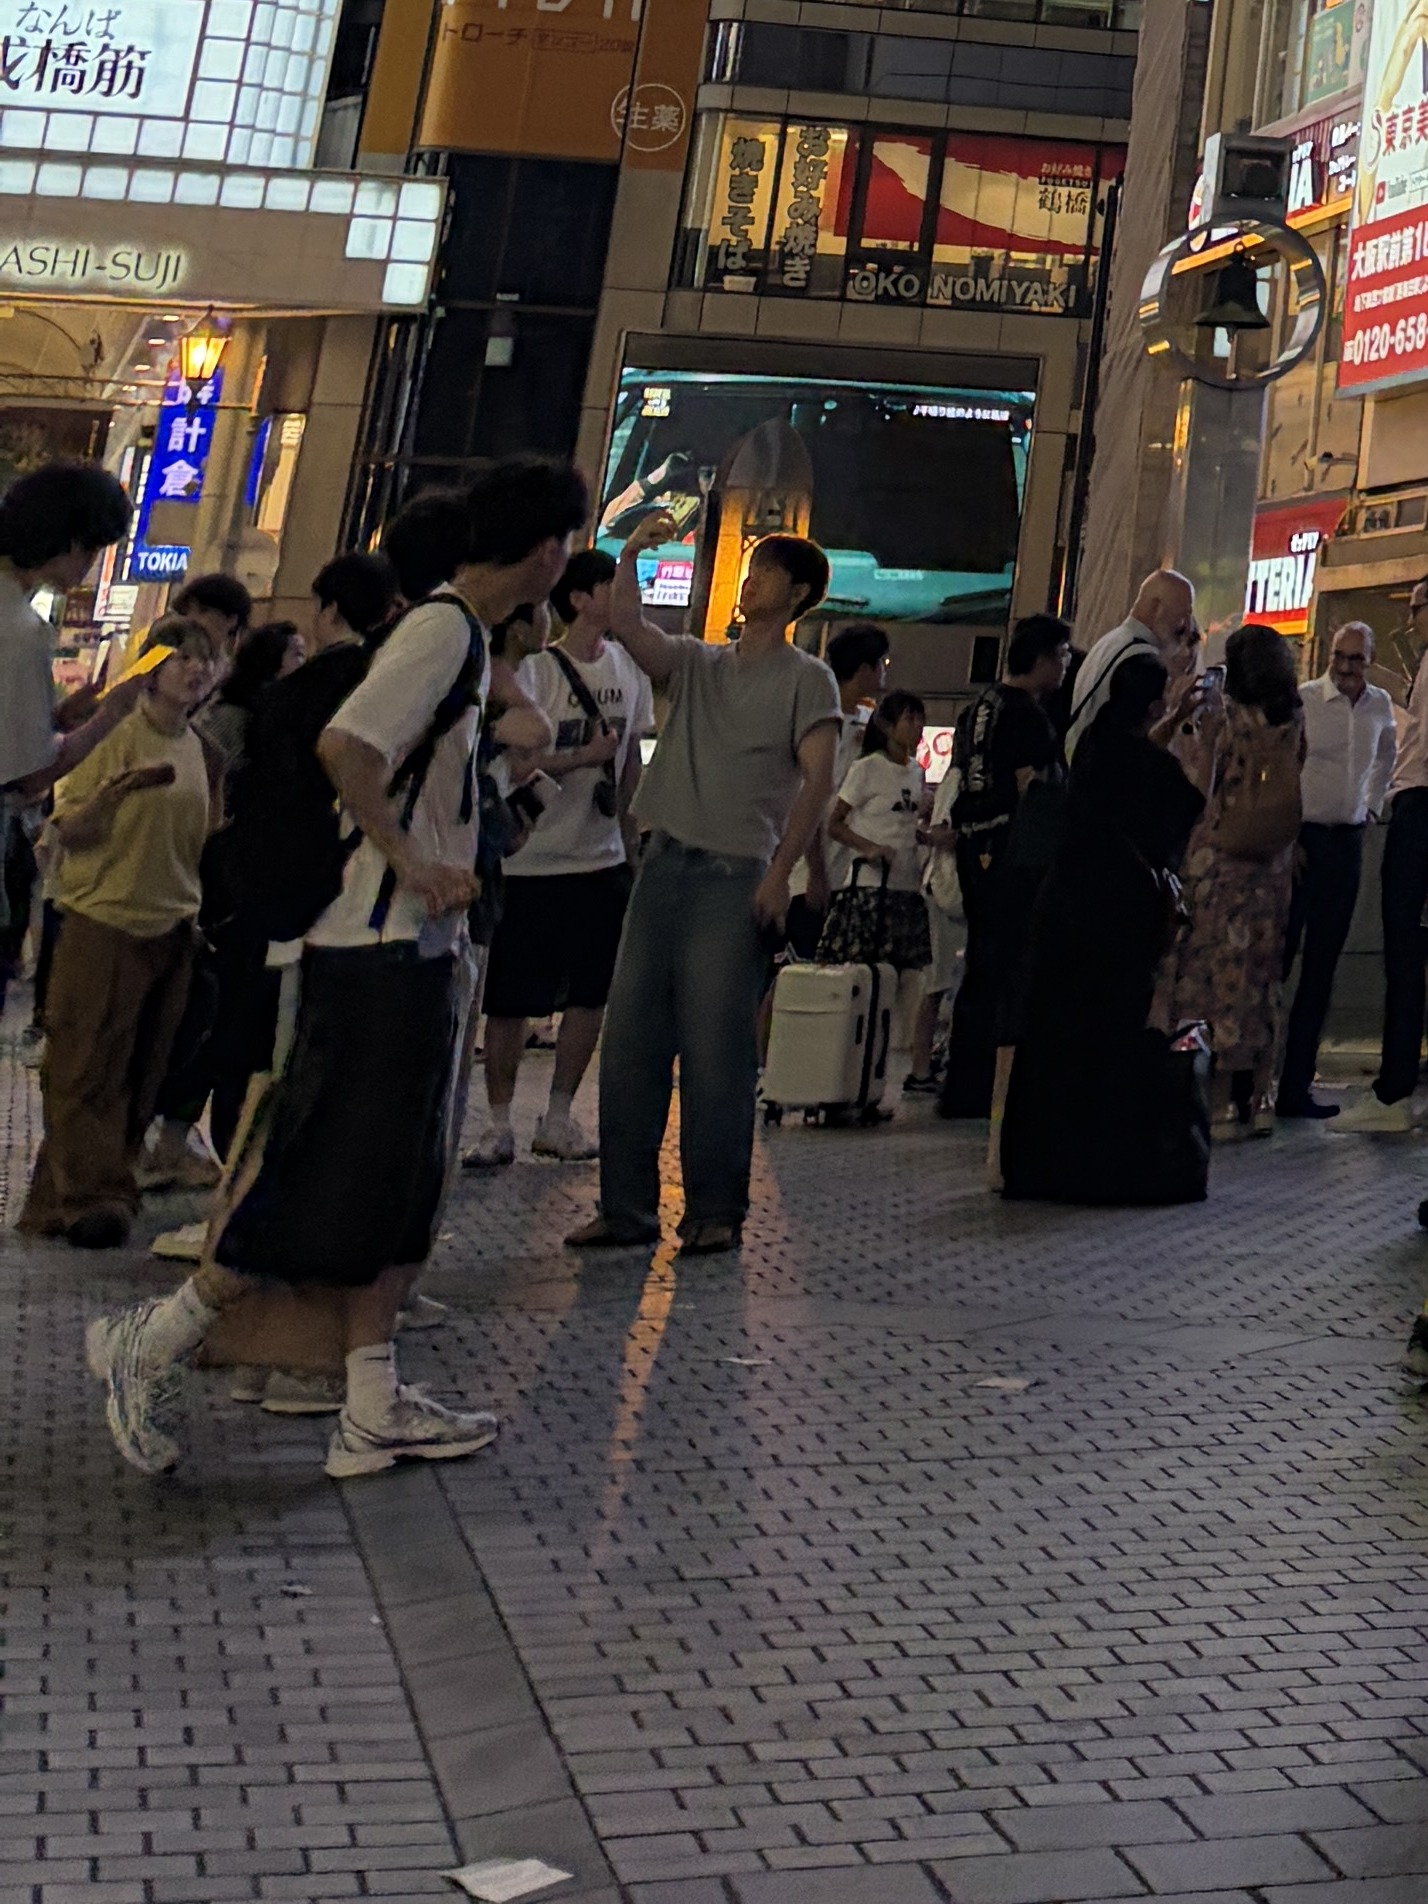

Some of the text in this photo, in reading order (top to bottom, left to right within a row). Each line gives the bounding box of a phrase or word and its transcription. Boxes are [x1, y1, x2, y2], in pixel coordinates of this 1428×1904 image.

[16, 1, 123, 41] なんば
[718, 137, 766, 270] 焼きそば
[0, 245, 183, 290] ASHI-SUJI
[138, 550, 189, 572] TOKIA
